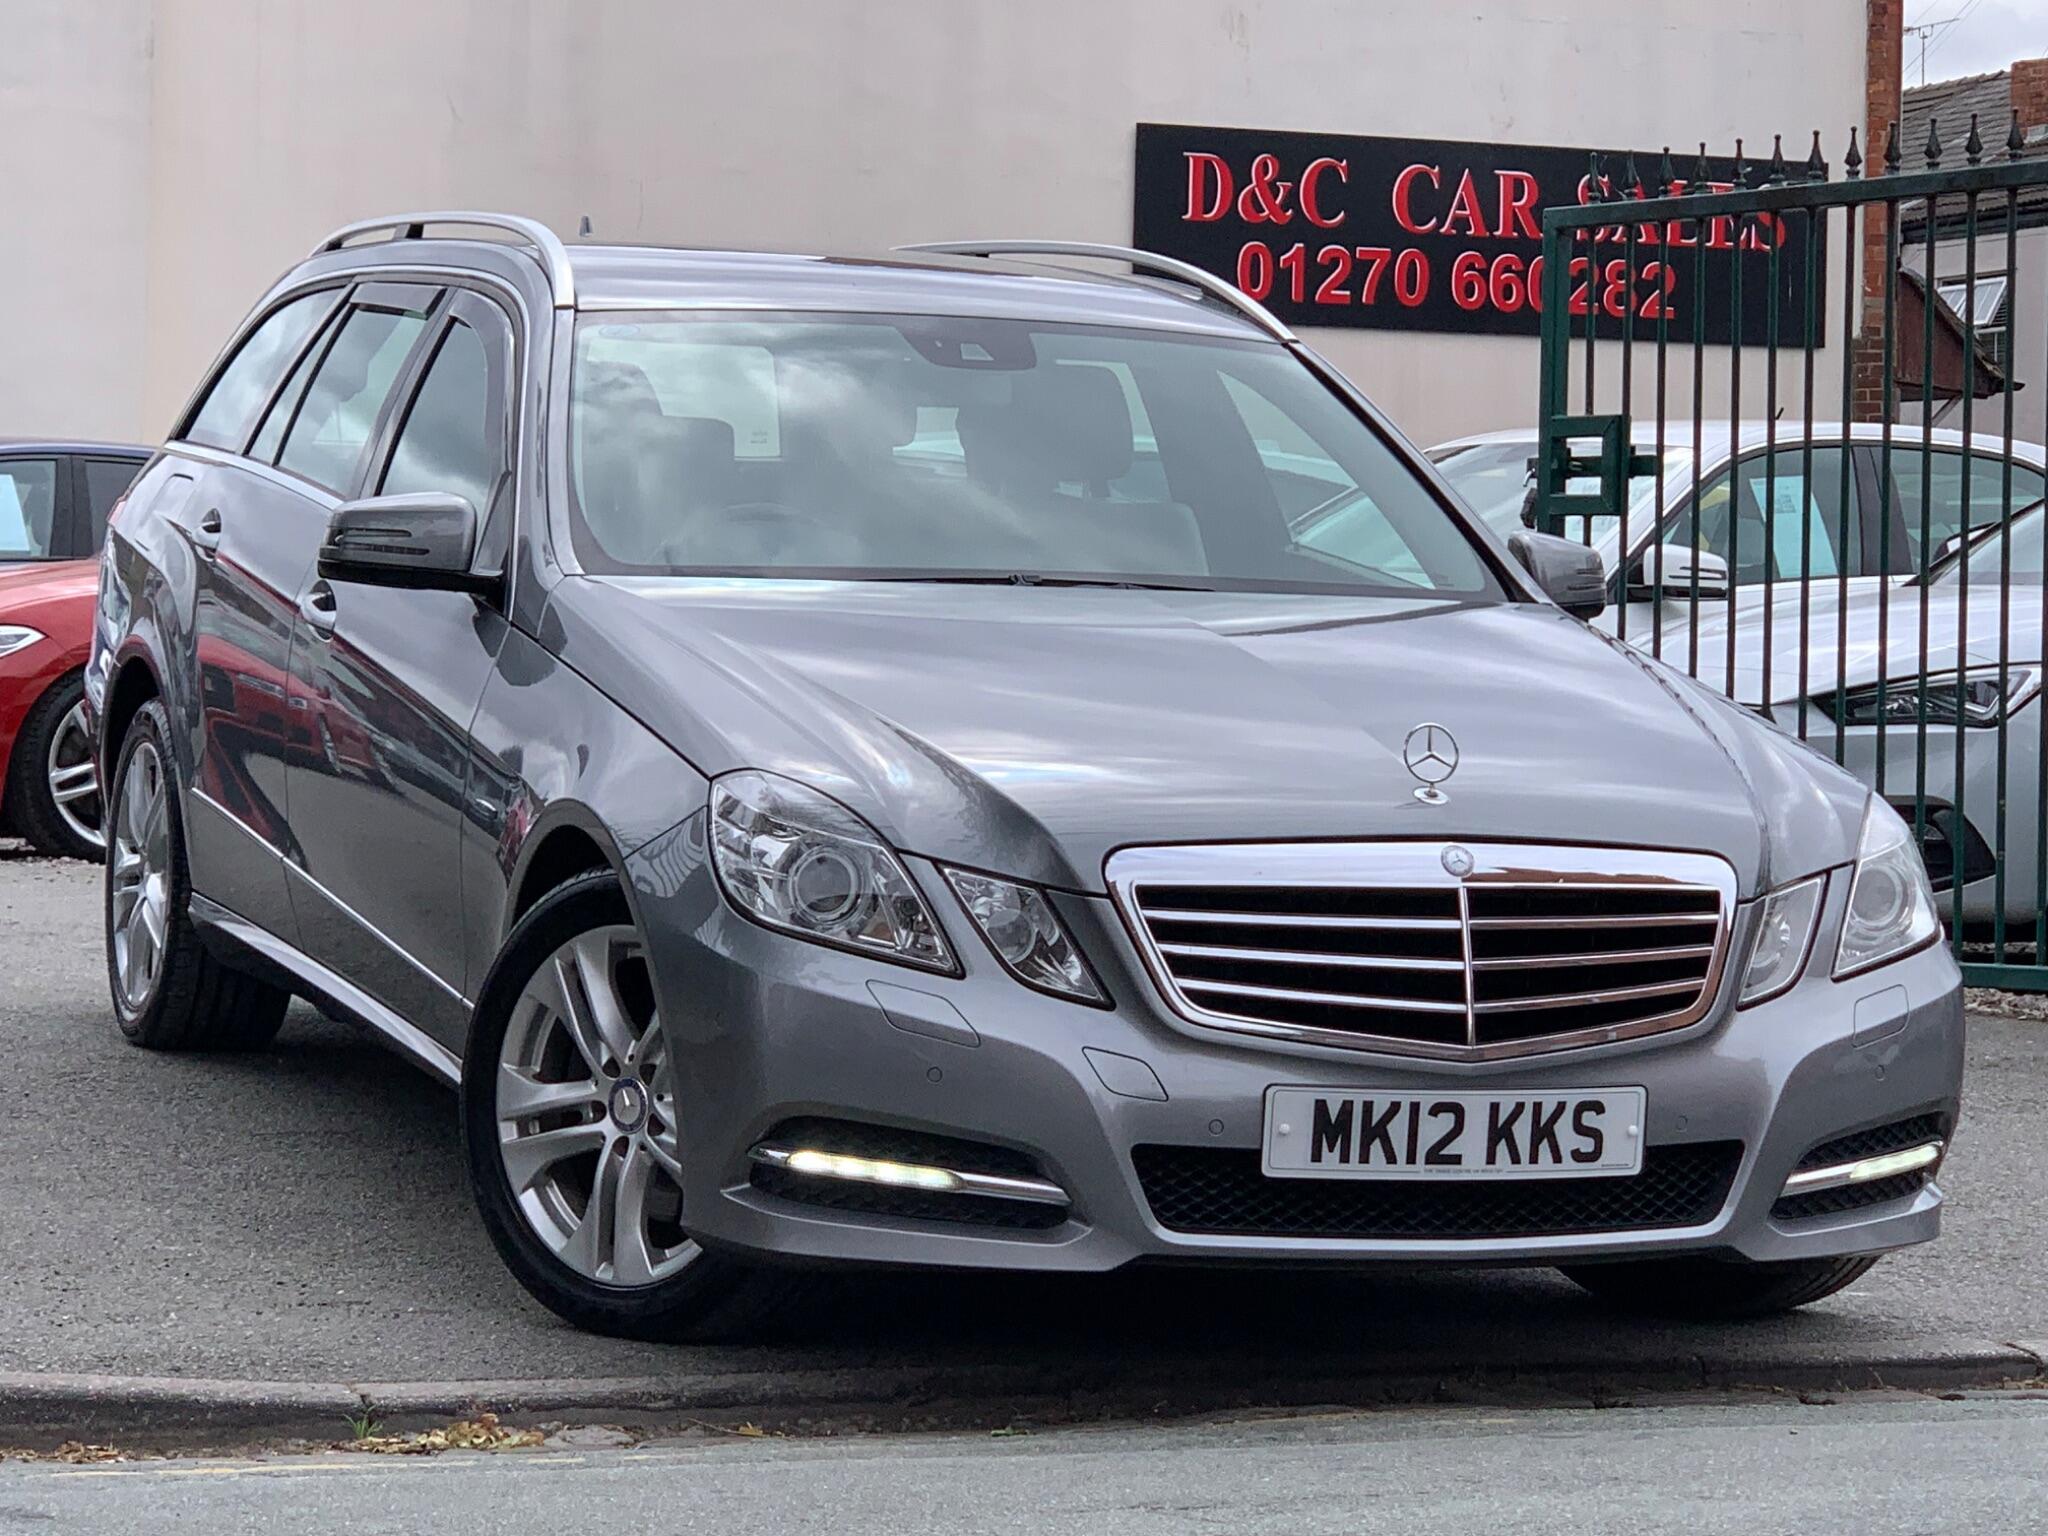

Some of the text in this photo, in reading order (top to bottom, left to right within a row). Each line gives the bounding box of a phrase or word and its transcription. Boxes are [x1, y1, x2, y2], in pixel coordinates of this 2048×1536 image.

[1181, 151, 1349, 229] D&C
[1391, 165, 1545, 240] CAR
[1235, 240, 1430, 308] 01270
[1310, 1098, 1607, 1165] MK12 KKS
